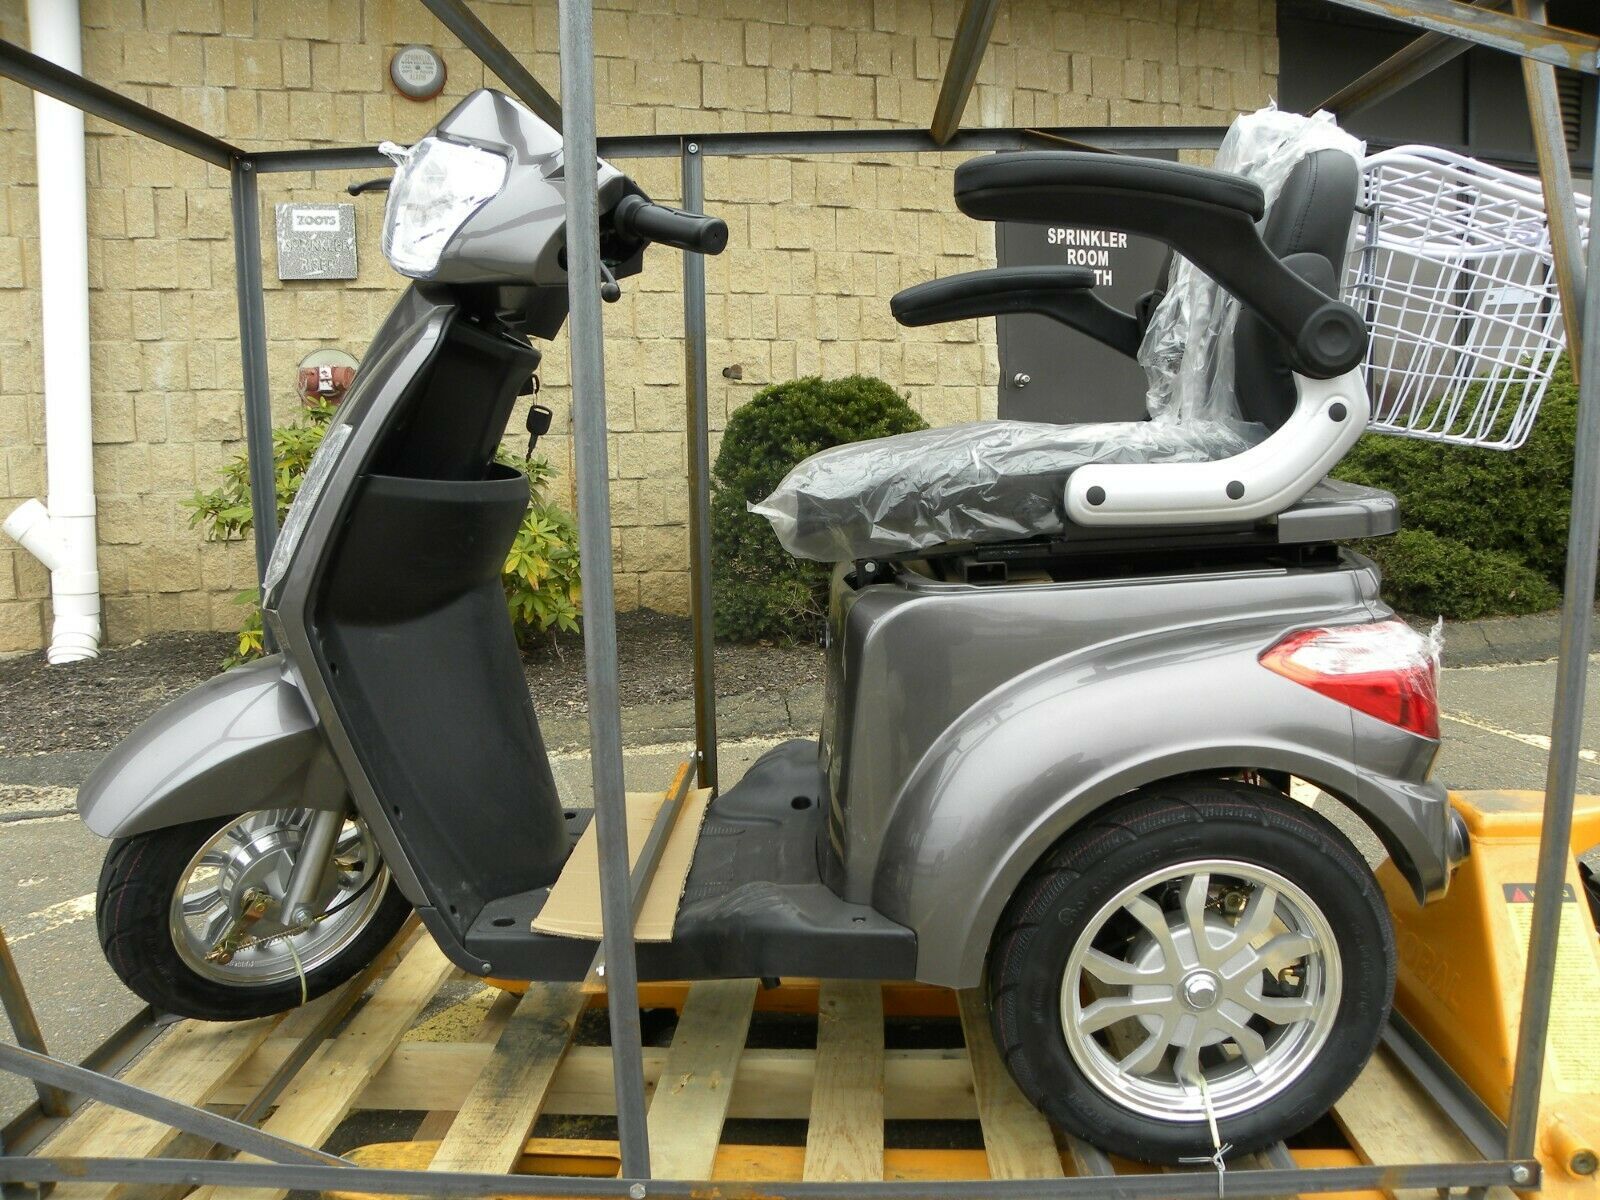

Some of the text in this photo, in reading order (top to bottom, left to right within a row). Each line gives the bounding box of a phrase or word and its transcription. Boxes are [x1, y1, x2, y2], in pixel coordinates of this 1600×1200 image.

[297, 215, 336, 226] ZOOTS
[1047, 227, 1128, 249] SPRINKLER
[1067, 248, 1109, 267] ROOM
[1092, 269, 1113, 286] TH
